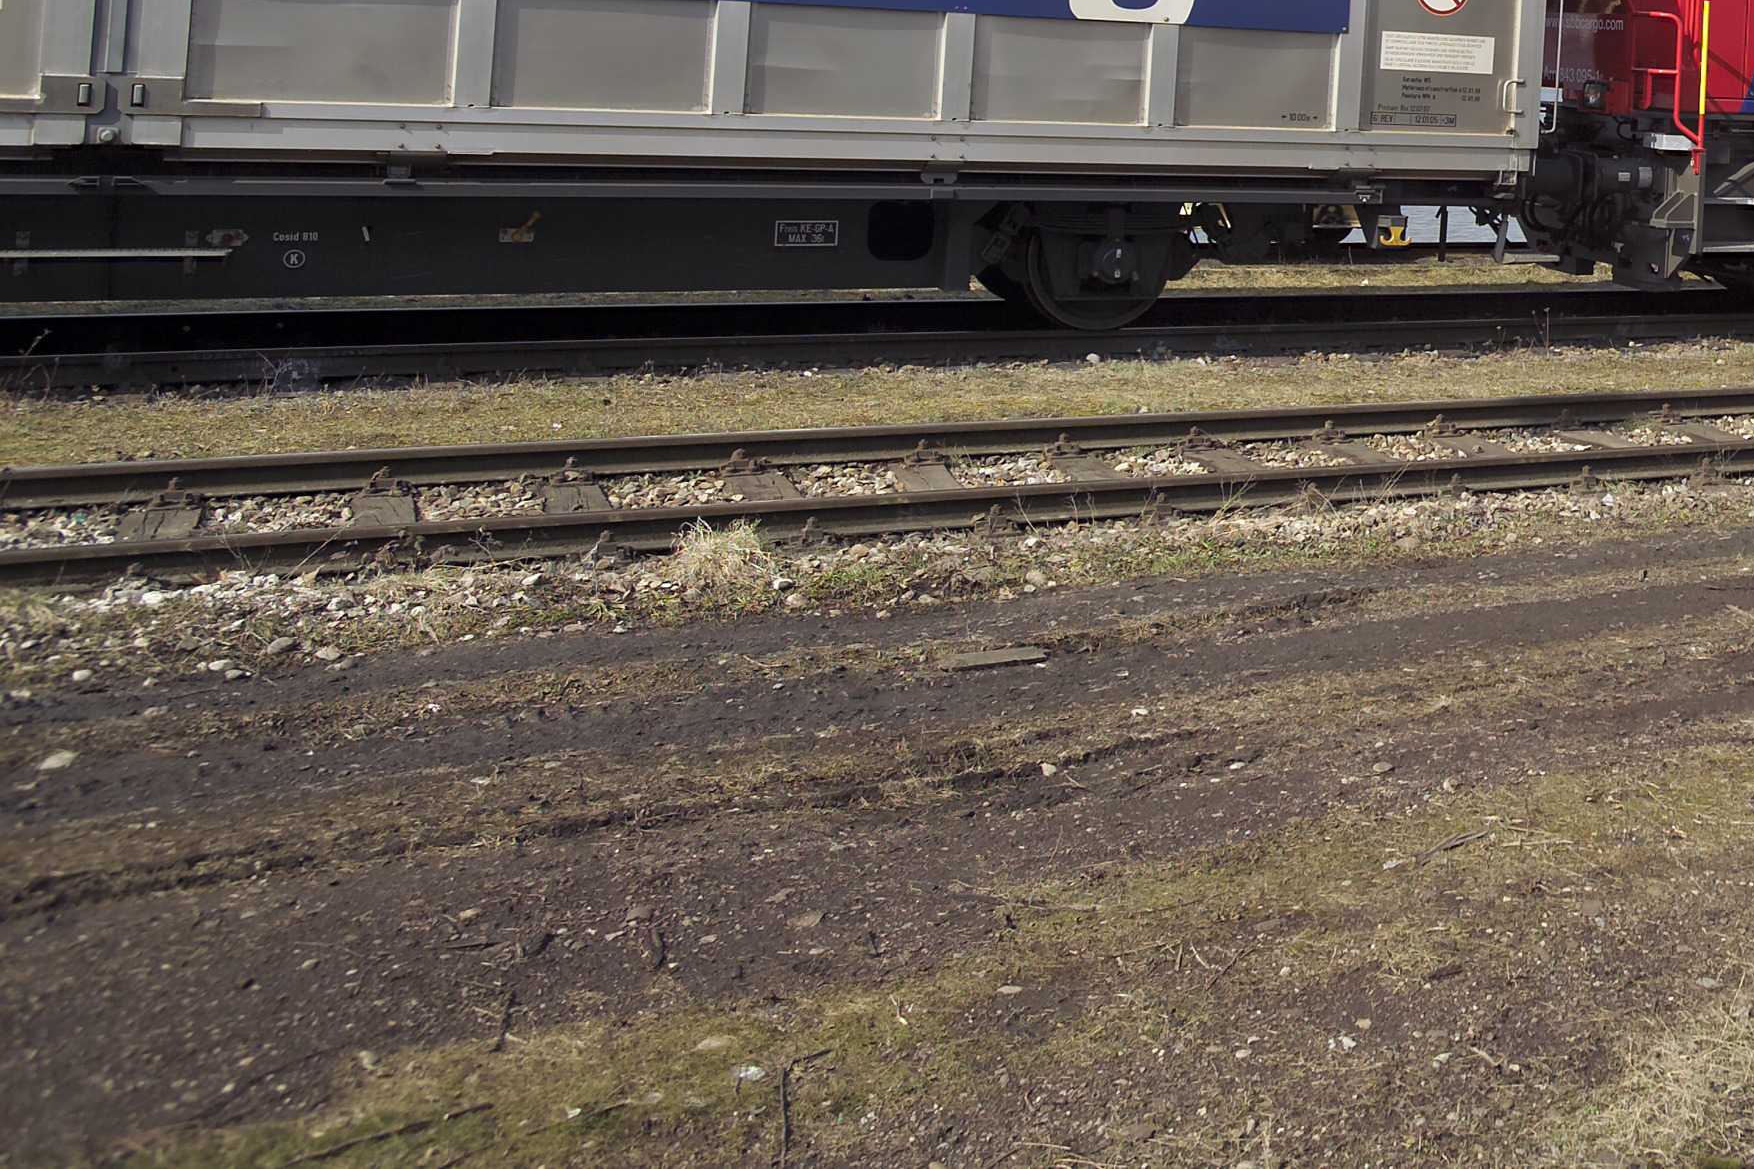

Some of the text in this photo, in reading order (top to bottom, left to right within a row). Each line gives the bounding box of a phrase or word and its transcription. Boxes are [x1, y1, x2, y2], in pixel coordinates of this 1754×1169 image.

[1380, 114, 1393, 123] REV
[800, 223, 834, 233] KE-GP-A
[273, 231, 319, 241] Cosid 810
[788, 233, 807, 243] MAX
[290, 253, 299, 265] K
